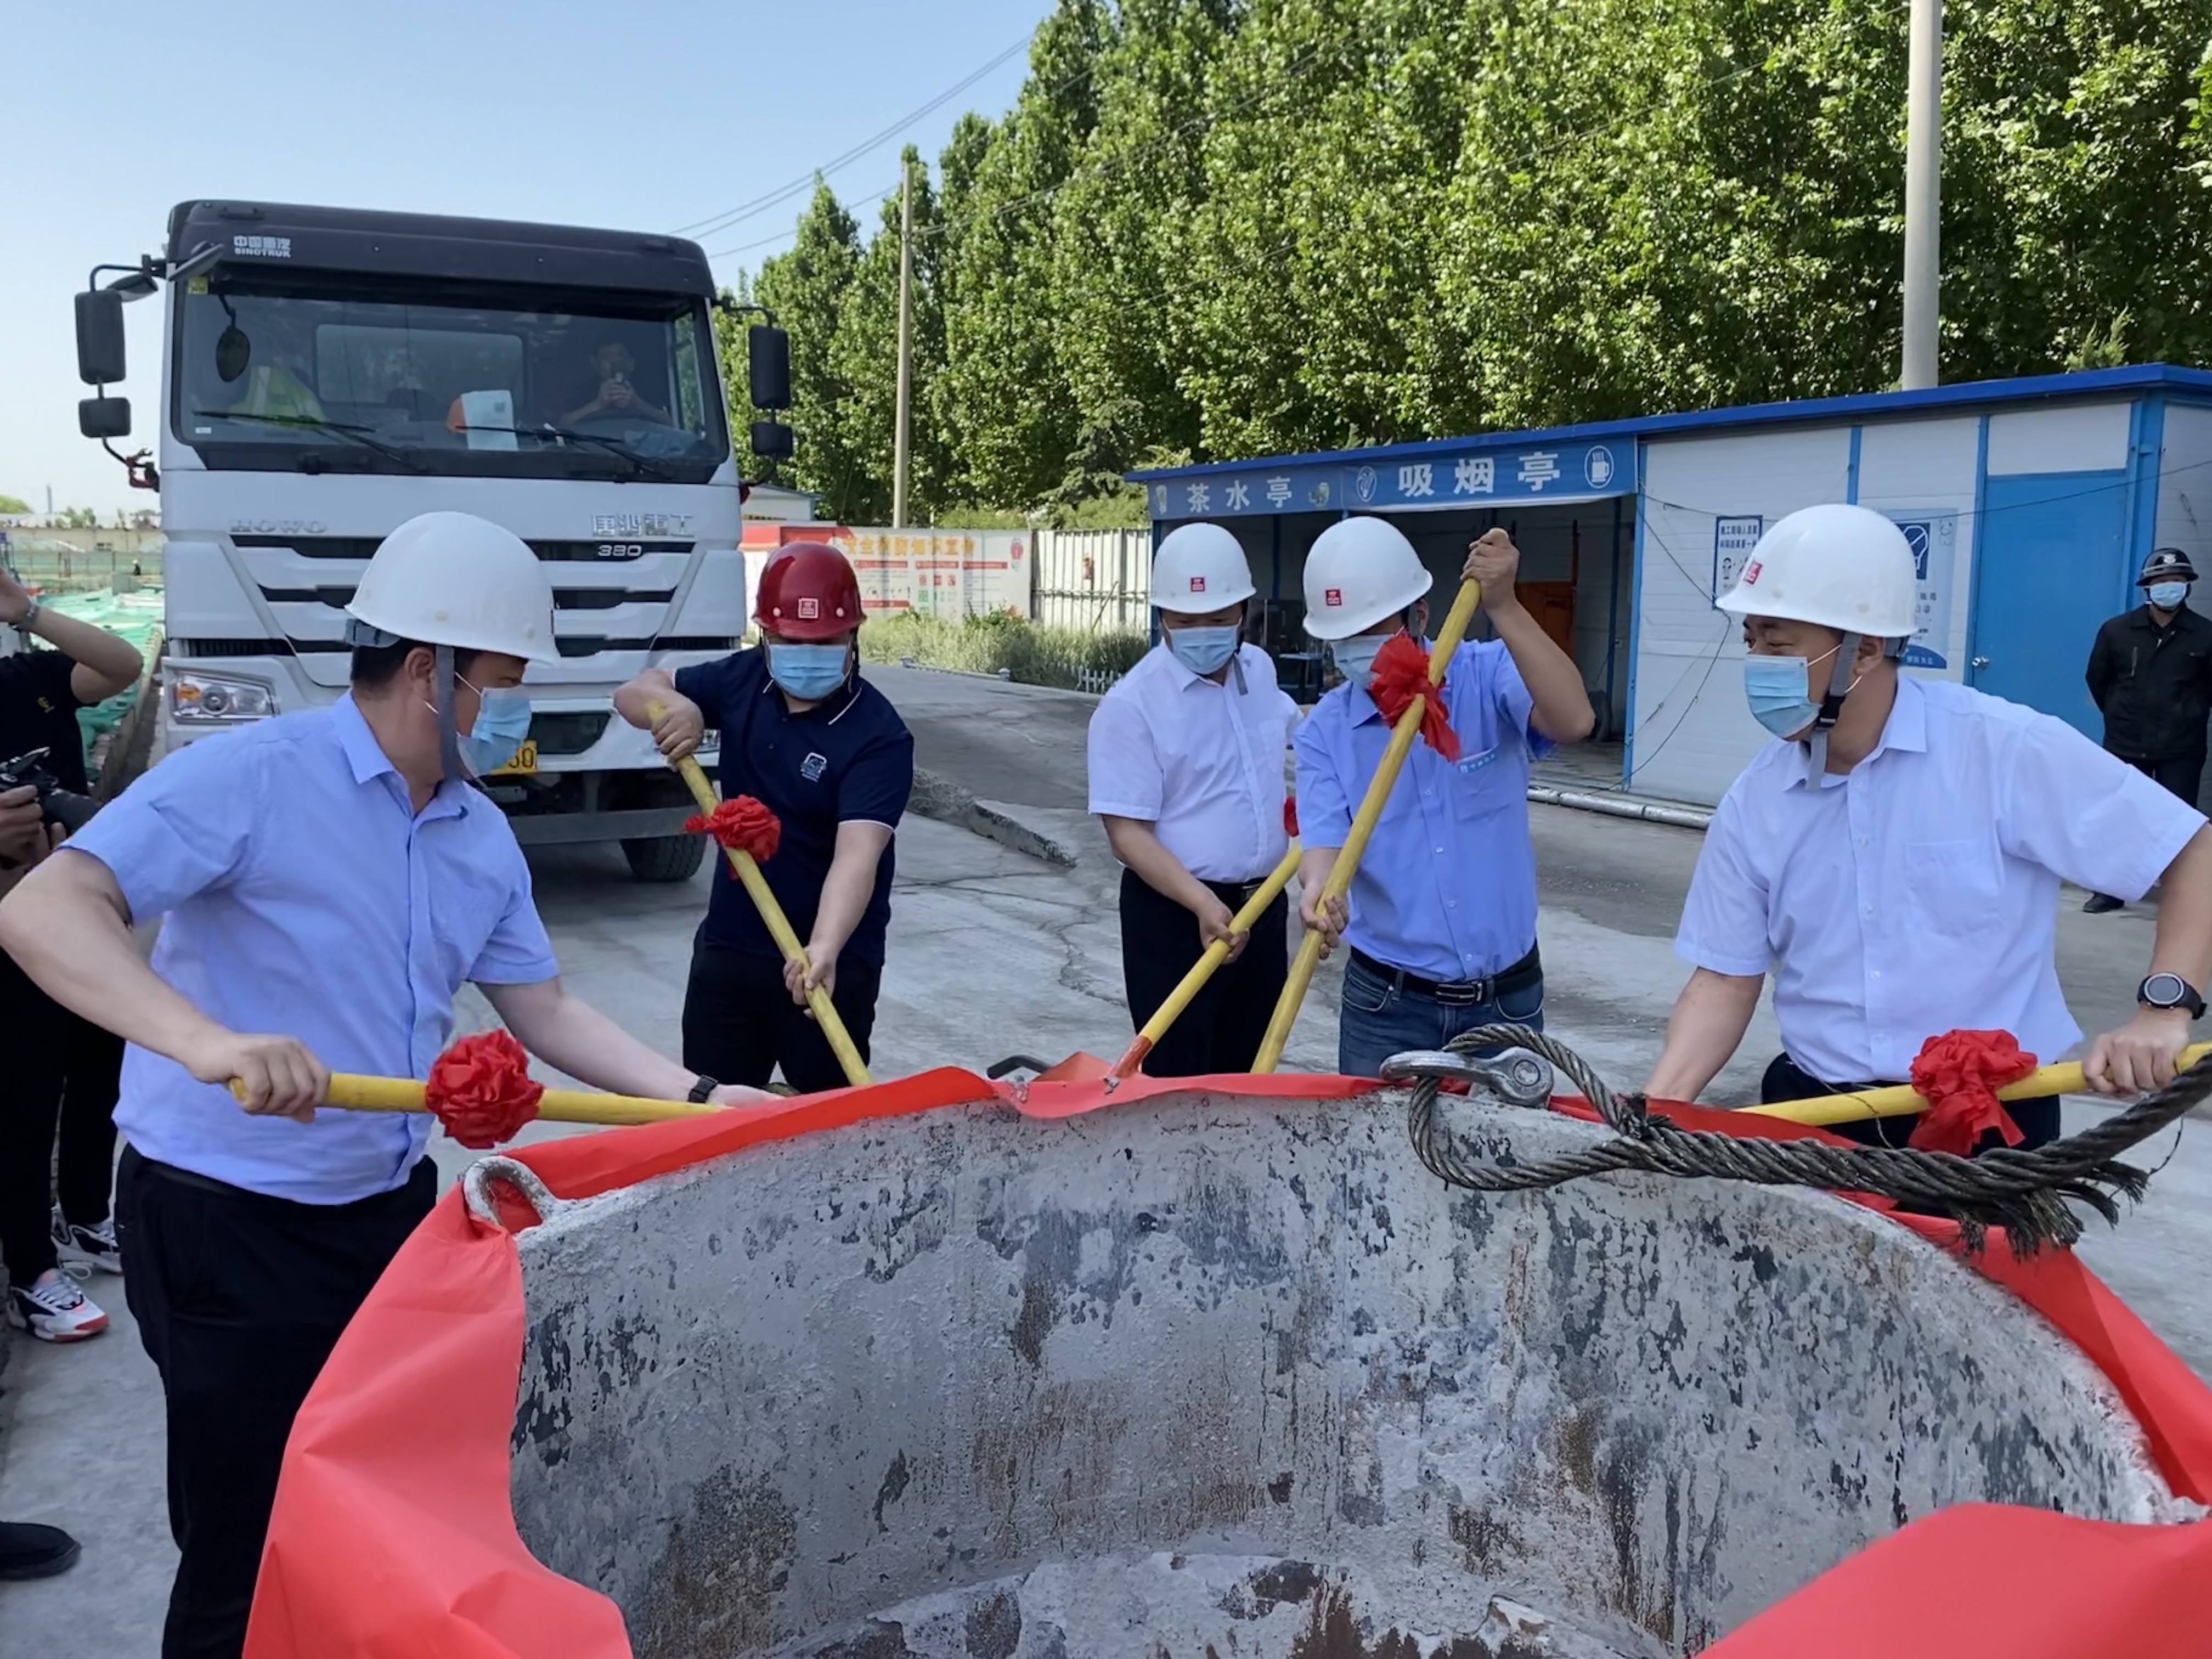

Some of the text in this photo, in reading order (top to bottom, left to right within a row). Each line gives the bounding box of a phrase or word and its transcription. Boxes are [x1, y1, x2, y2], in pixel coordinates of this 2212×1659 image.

[234, 247, 291, 258] SINOTRUK
[1398, 452, 1560, 497] 吸烟亭
[1187, 476, 1292, 513] 茶水亭
[228, 520, 328, 533] HOWO
[598, 545, 642, 556] 380
